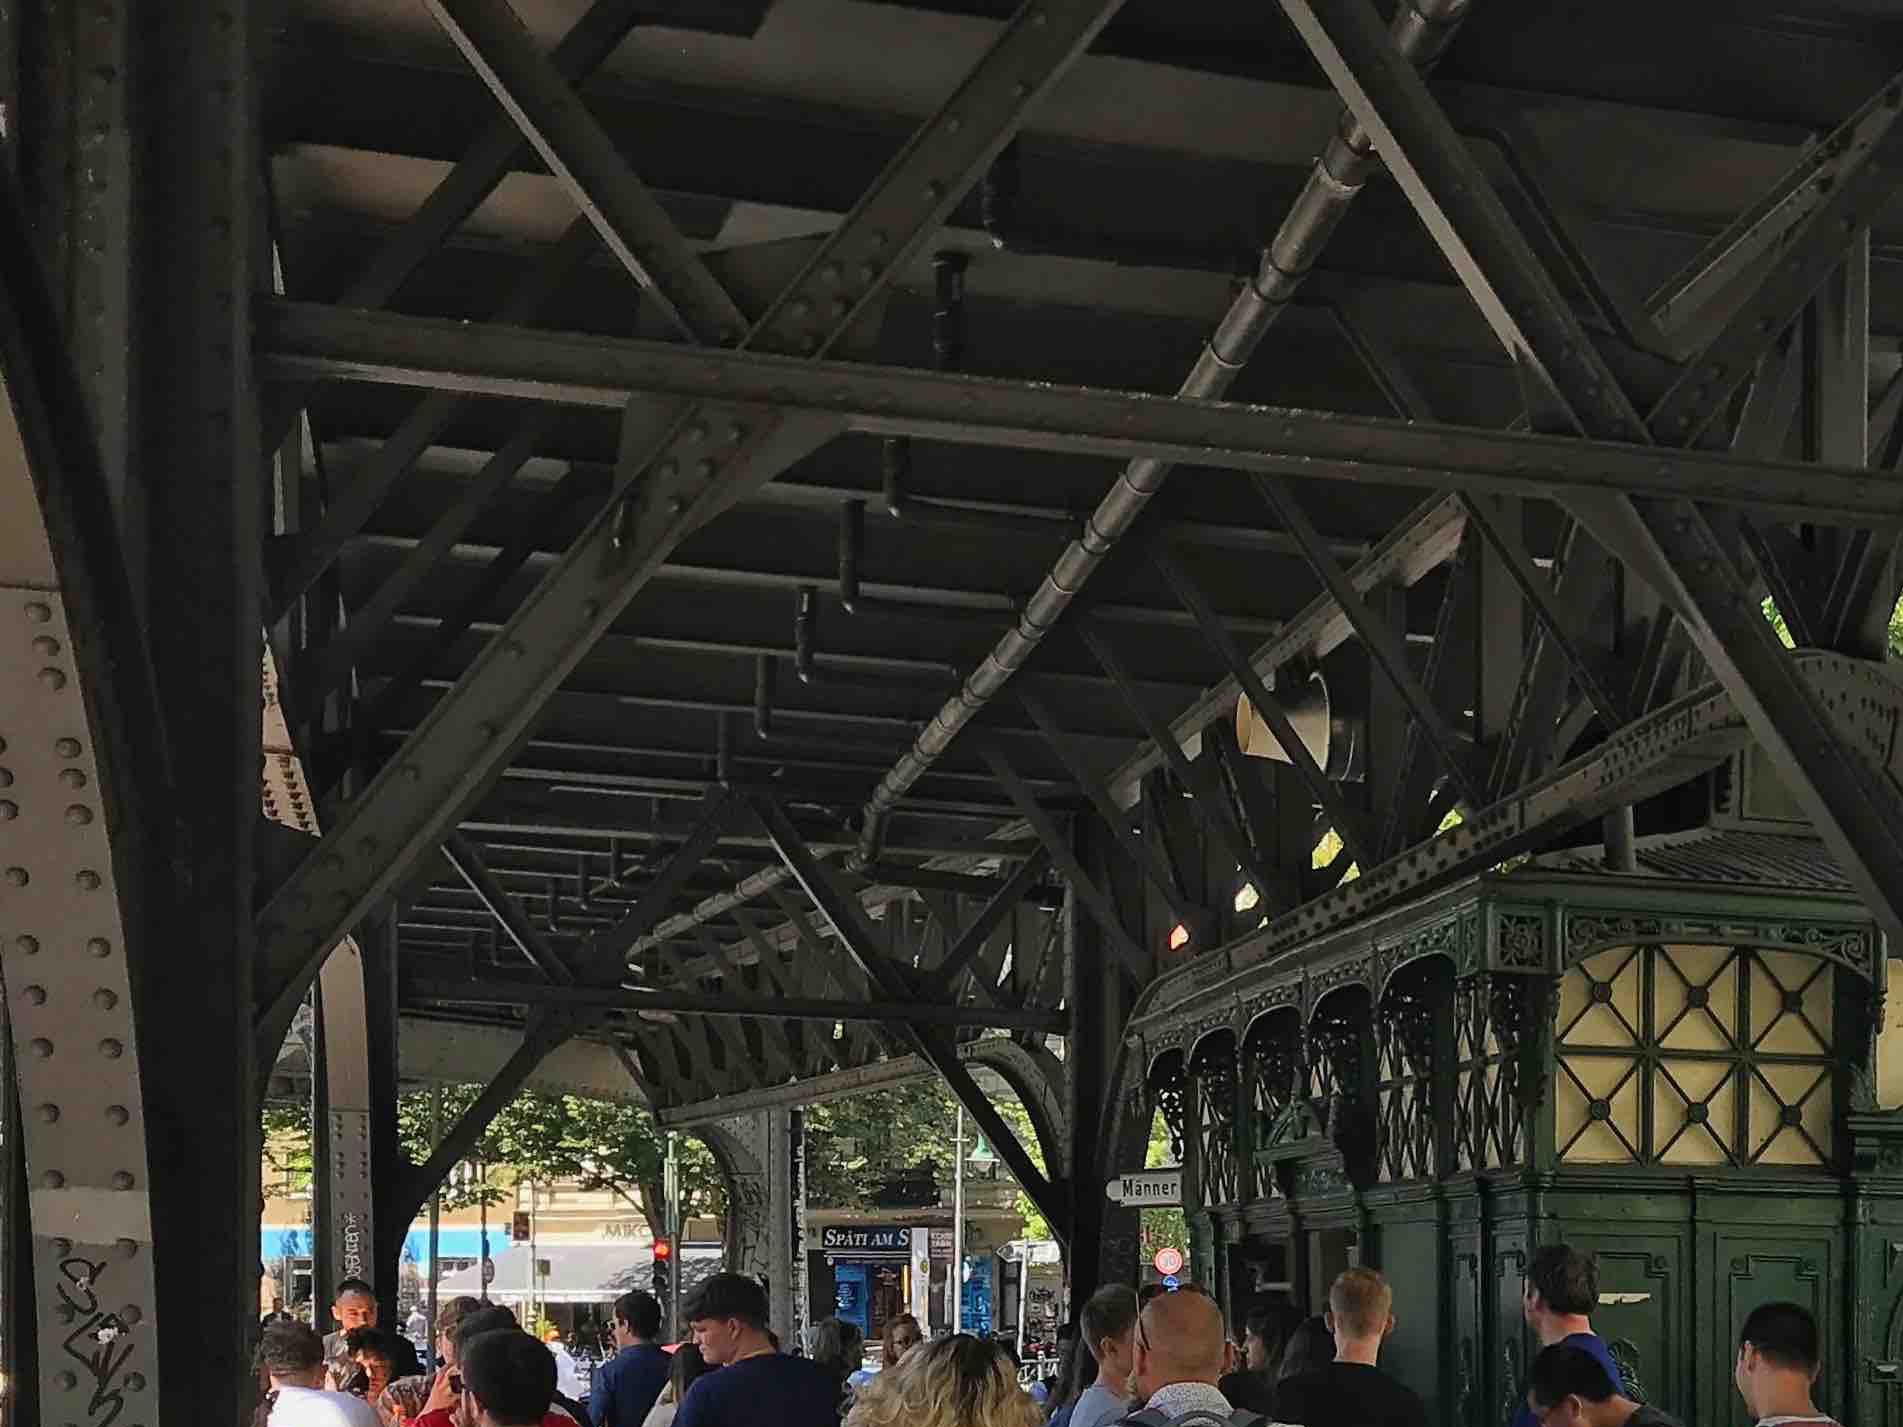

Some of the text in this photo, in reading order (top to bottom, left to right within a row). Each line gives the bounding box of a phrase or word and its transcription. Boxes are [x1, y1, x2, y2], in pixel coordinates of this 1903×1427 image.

[1121, 1177, 1178, 1198] Männer
[824, 1227, 868, 1247] SPÄTI
[871, 1232, 894, 1247] AM
[896, 1227, 911, 1246] S
